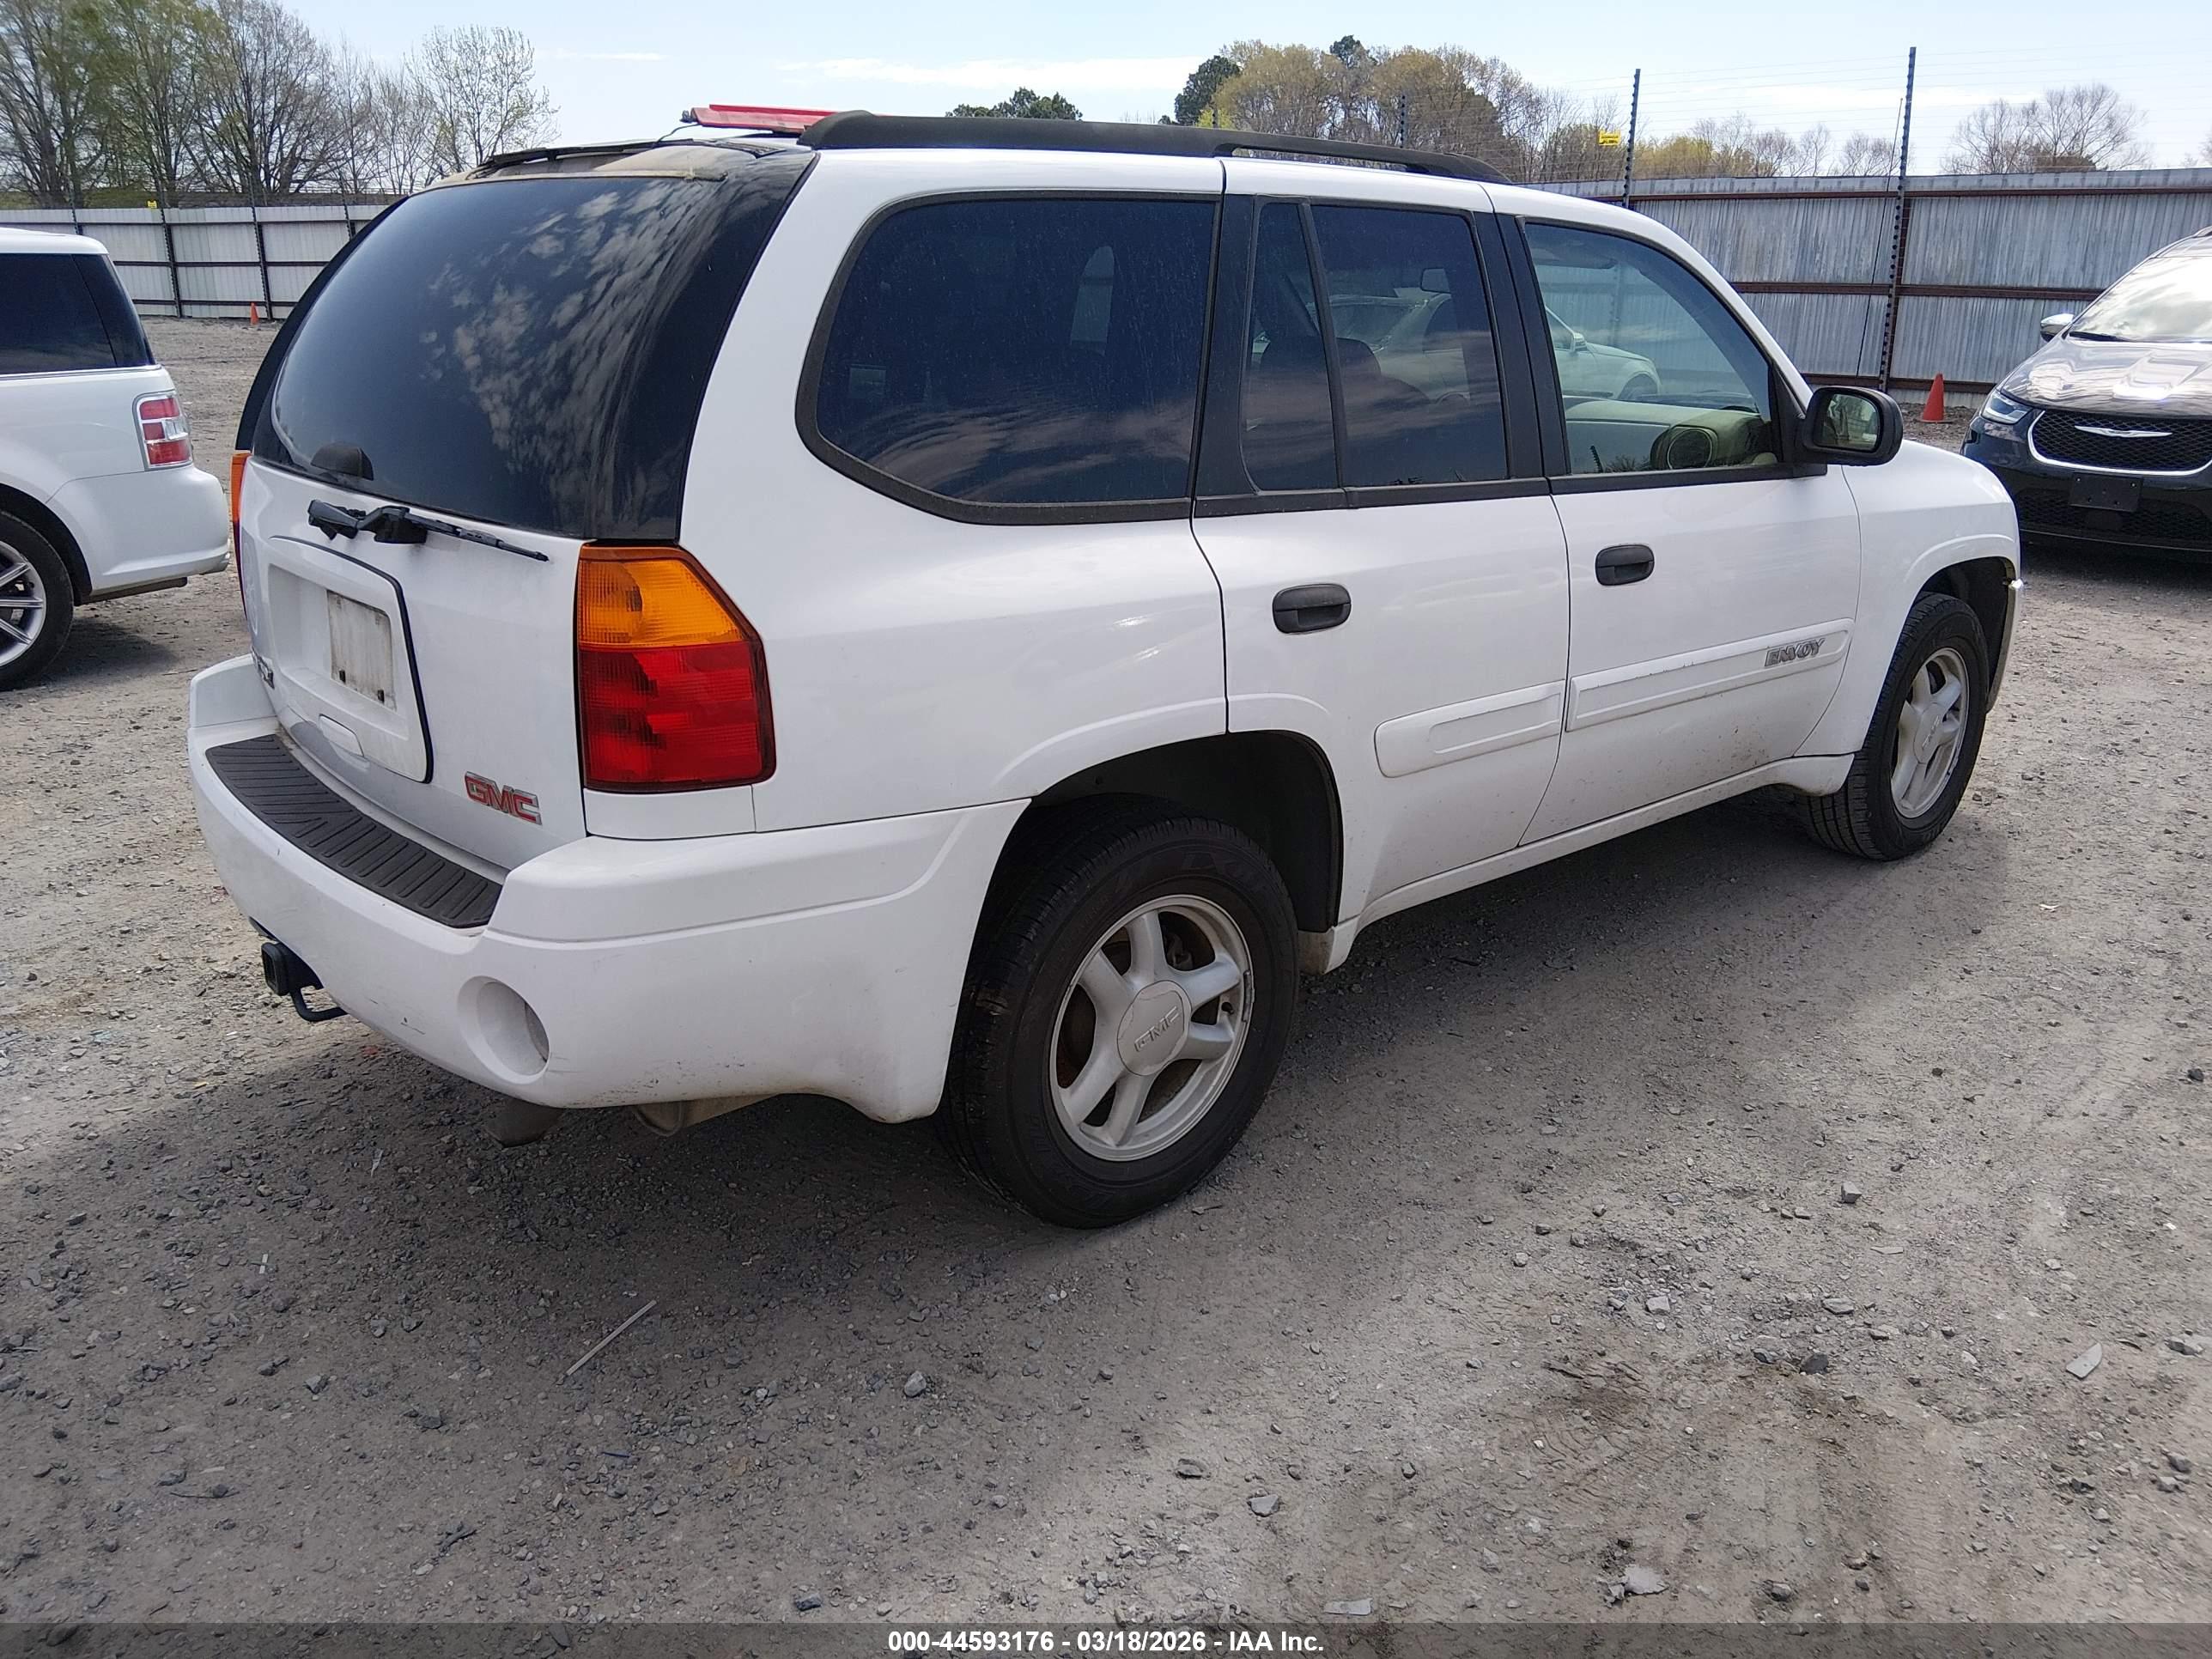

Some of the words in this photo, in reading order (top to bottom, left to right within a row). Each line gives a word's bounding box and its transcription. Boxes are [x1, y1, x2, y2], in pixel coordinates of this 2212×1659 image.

[1765, 638, 1826, 667] ENVOY
[465, 770, 543, 826] GMC
[1134, 1006, 1179, 1053] GMC
